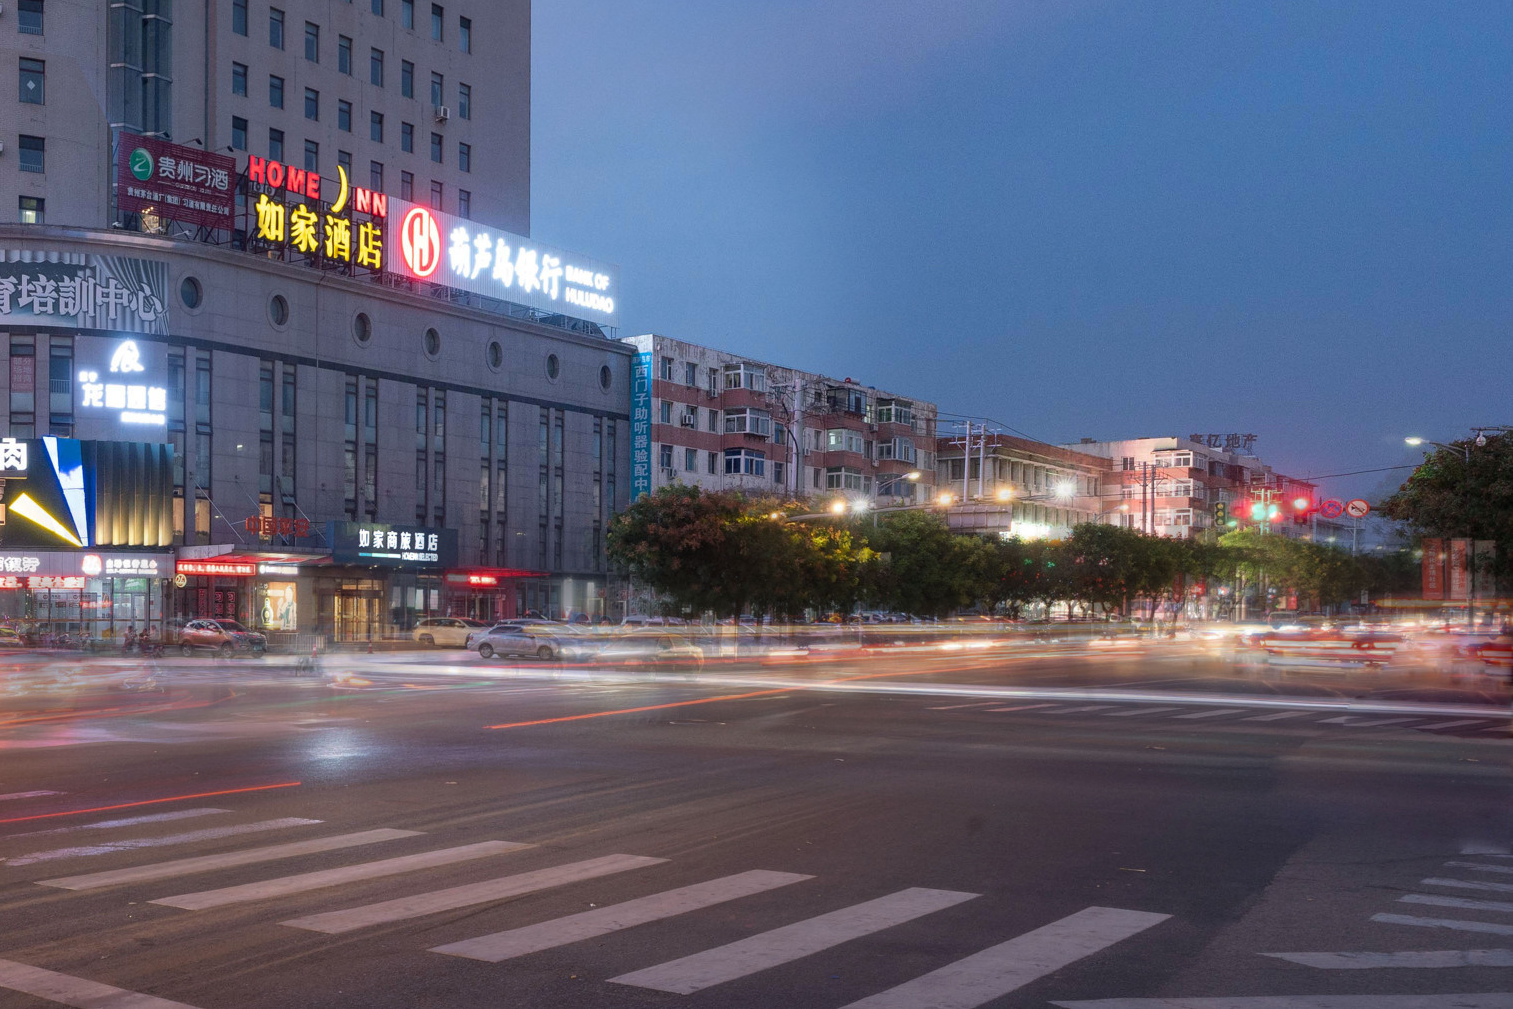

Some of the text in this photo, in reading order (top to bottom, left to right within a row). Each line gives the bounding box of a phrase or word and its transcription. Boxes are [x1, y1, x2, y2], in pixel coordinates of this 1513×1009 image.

[158, 156, 229, 190] 贵州习酒
[249, 155, 320, 199] HOME
[255, 193, 382, 269] 如家酒店
[594, 273, 610, 291] OF
[246, 515, 310, 538] 中国平安
[359, 529, 439, 551] 如家商旅酒店
